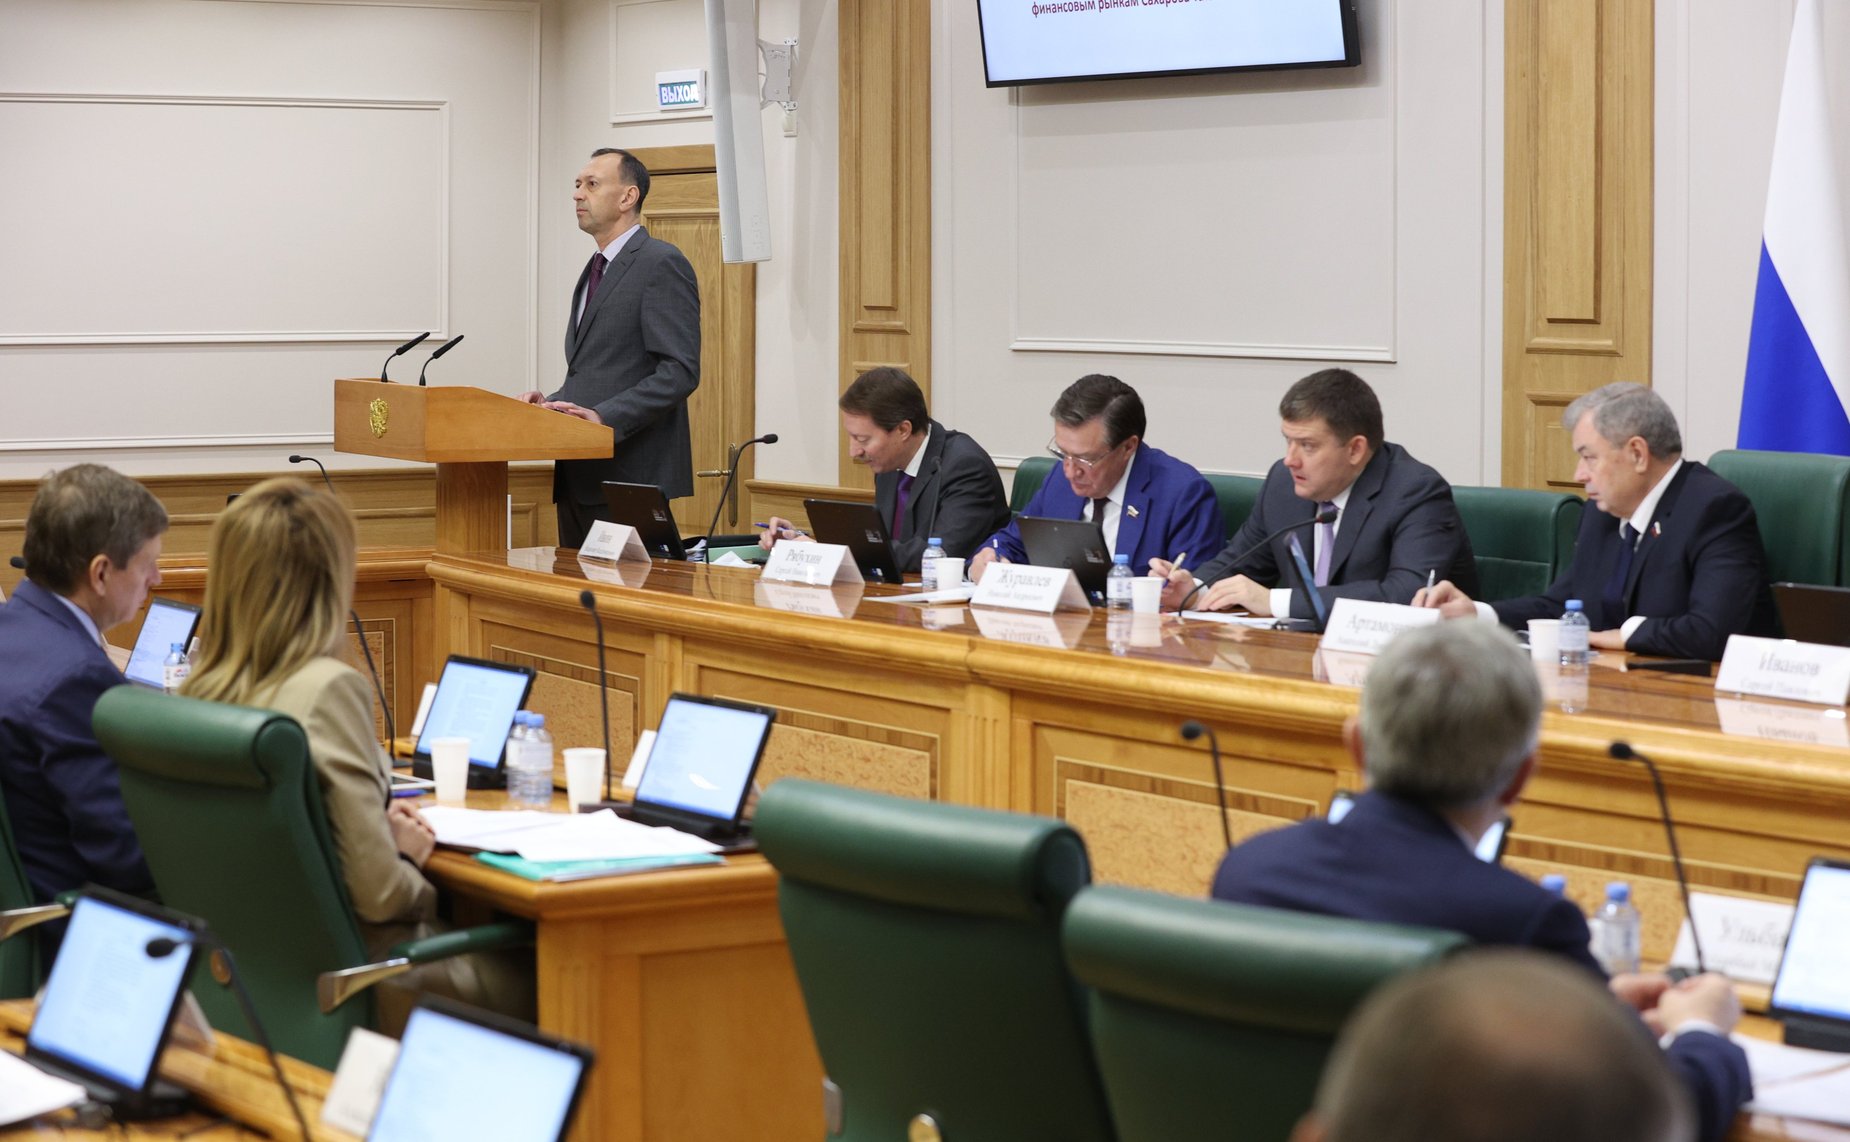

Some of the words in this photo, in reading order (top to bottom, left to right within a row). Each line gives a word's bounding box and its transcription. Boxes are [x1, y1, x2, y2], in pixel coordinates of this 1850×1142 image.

[1031, 1, 1097, 18] финансовым
[1098, 0, 1139, 13] рынкам
[660, 83, 699, 103] ВЫХОД
[1758, 651, 1821, 676] Иванов
